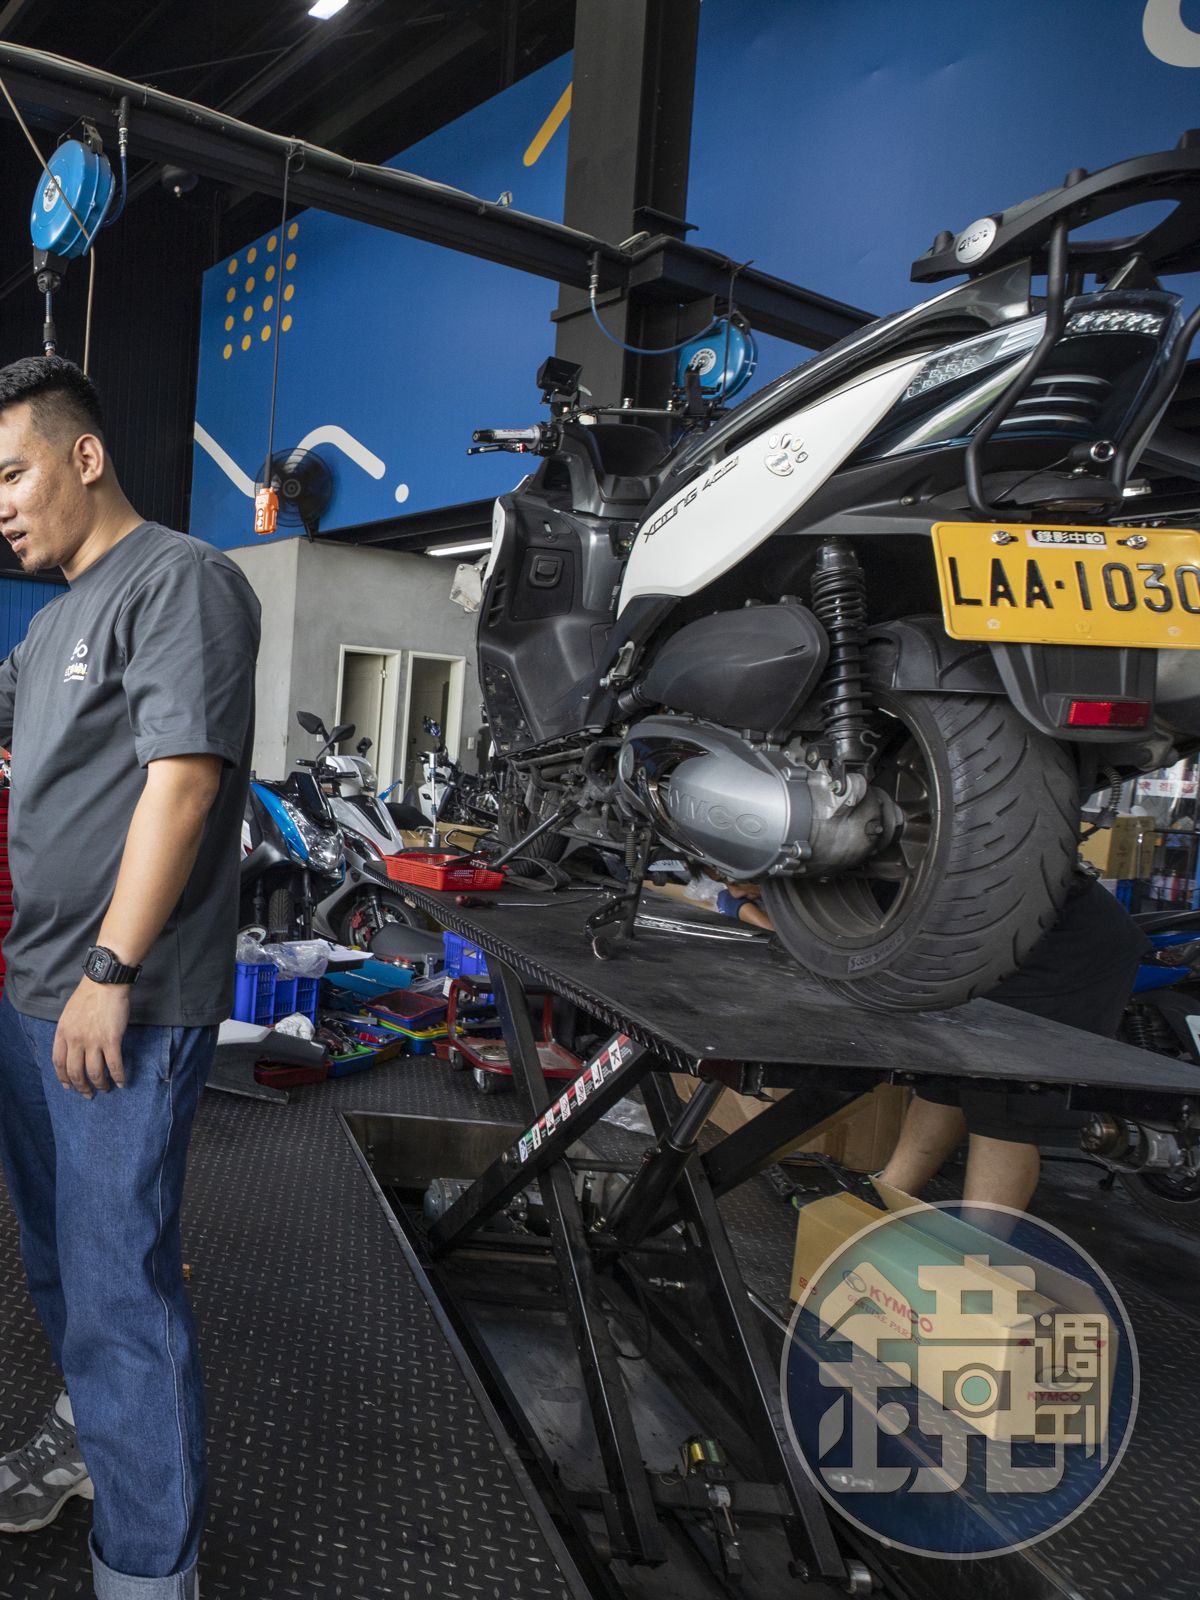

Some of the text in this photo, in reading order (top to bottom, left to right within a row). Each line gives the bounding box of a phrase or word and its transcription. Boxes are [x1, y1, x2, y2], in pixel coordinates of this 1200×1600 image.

[668, 788, 769, 840] YMCO
[869, 1285, 933, 1333] KYMCO
[1027, 1391, 1081, 1402] KYMCO
